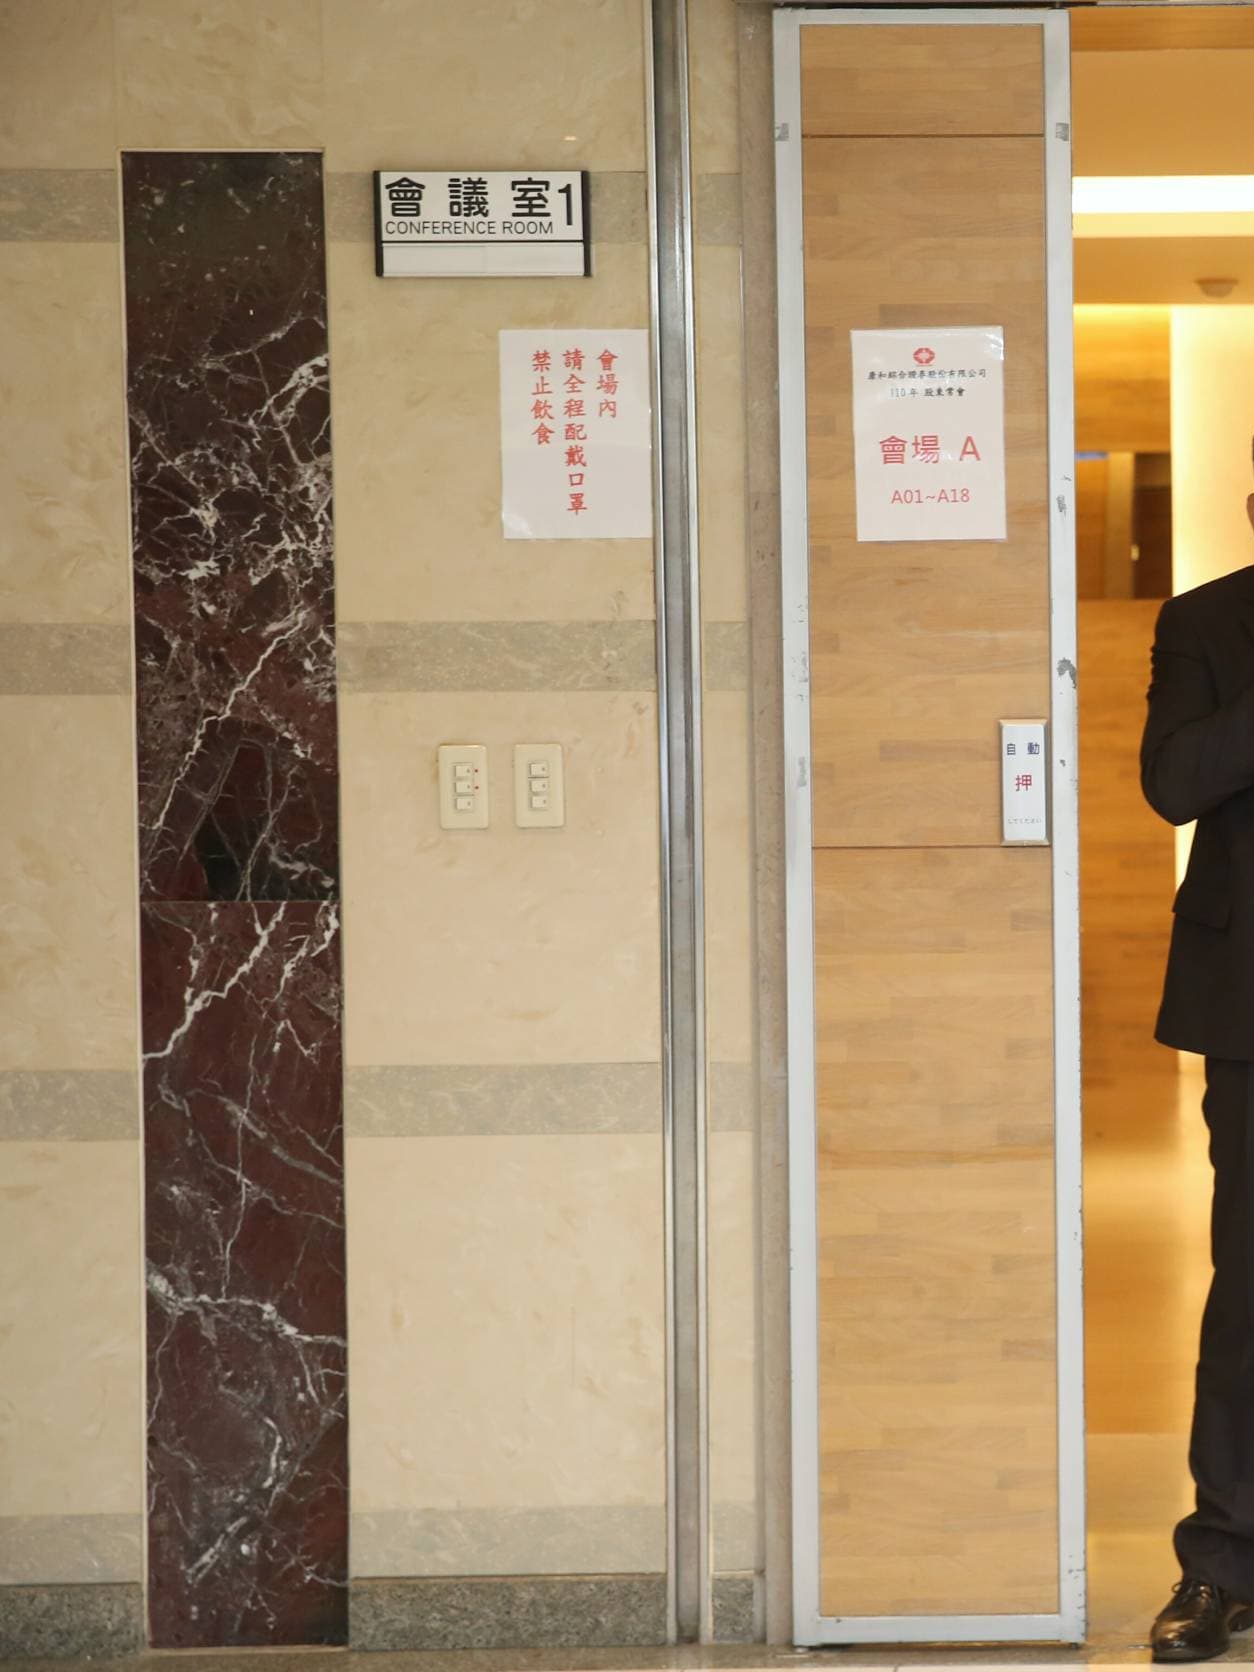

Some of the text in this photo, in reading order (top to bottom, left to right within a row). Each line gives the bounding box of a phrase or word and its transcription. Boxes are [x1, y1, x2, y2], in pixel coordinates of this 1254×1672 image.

[385, 221, 553, 235] CONFERENCE ROOM
[596, 350, 619, 419] 會場內
[531, 350, 555, 445] 禁止飲食
[562, 348, 588, 515] 請全程配戴口罩
[879, 435, 981, 465] 會場 A
[891, 488, 970, 504] A01~A18
[1006, 742, 1041, 756] 自動
[1015, 774, 1032, 792] 押
